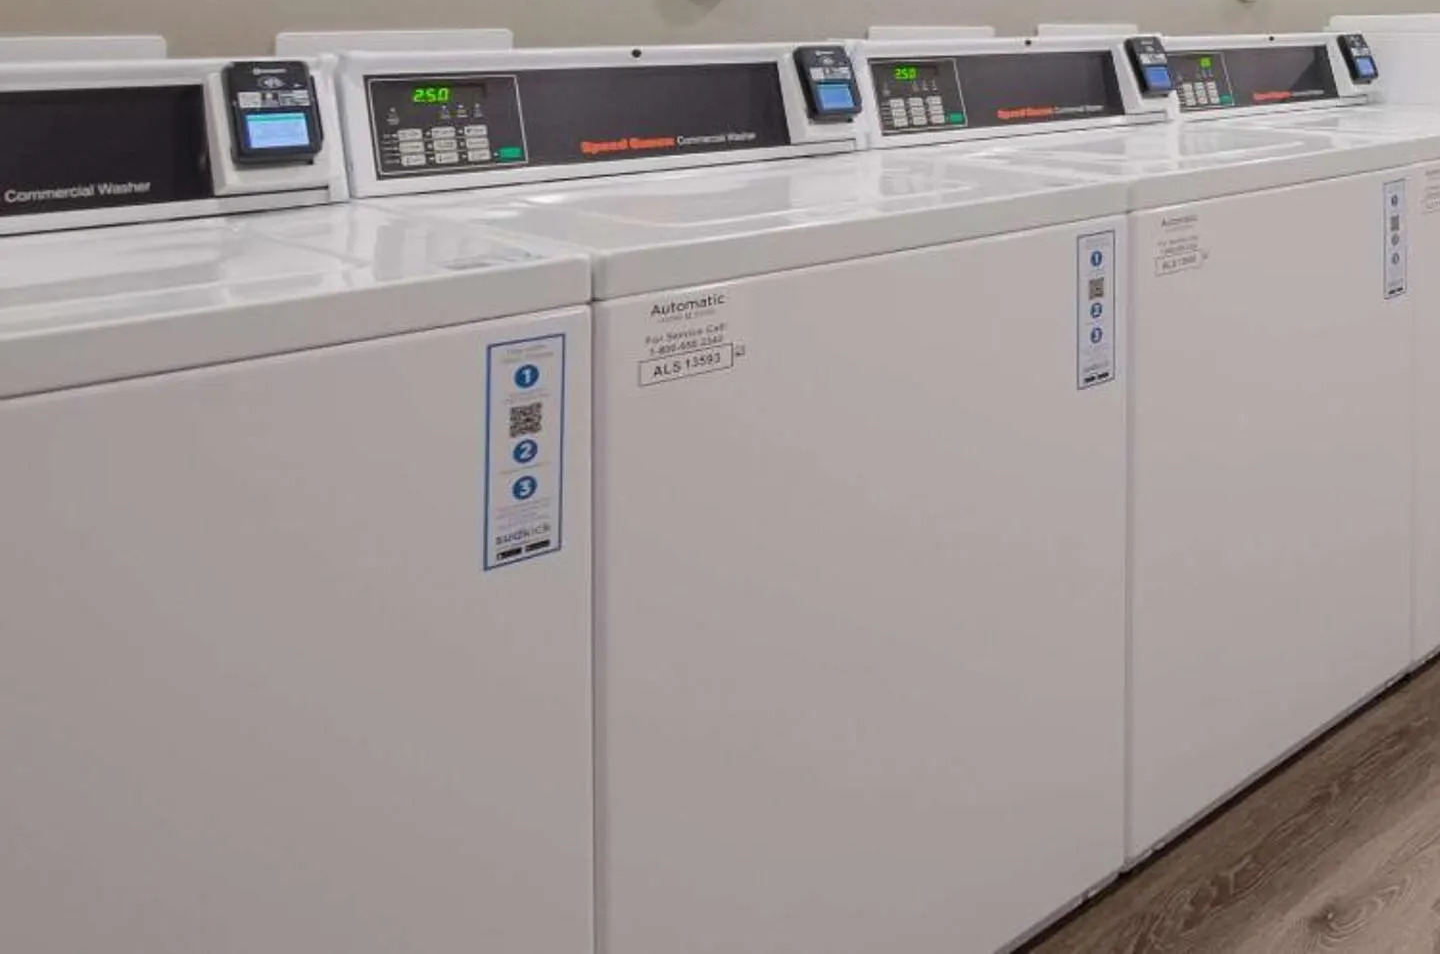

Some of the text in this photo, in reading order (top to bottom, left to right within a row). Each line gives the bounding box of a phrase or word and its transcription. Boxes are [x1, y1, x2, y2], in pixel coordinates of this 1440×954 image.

[4, 181, 151, 203] Commercial Washer
[651, 293, 726, 316] Automatic
[653, 360, 682, 377] ALS
